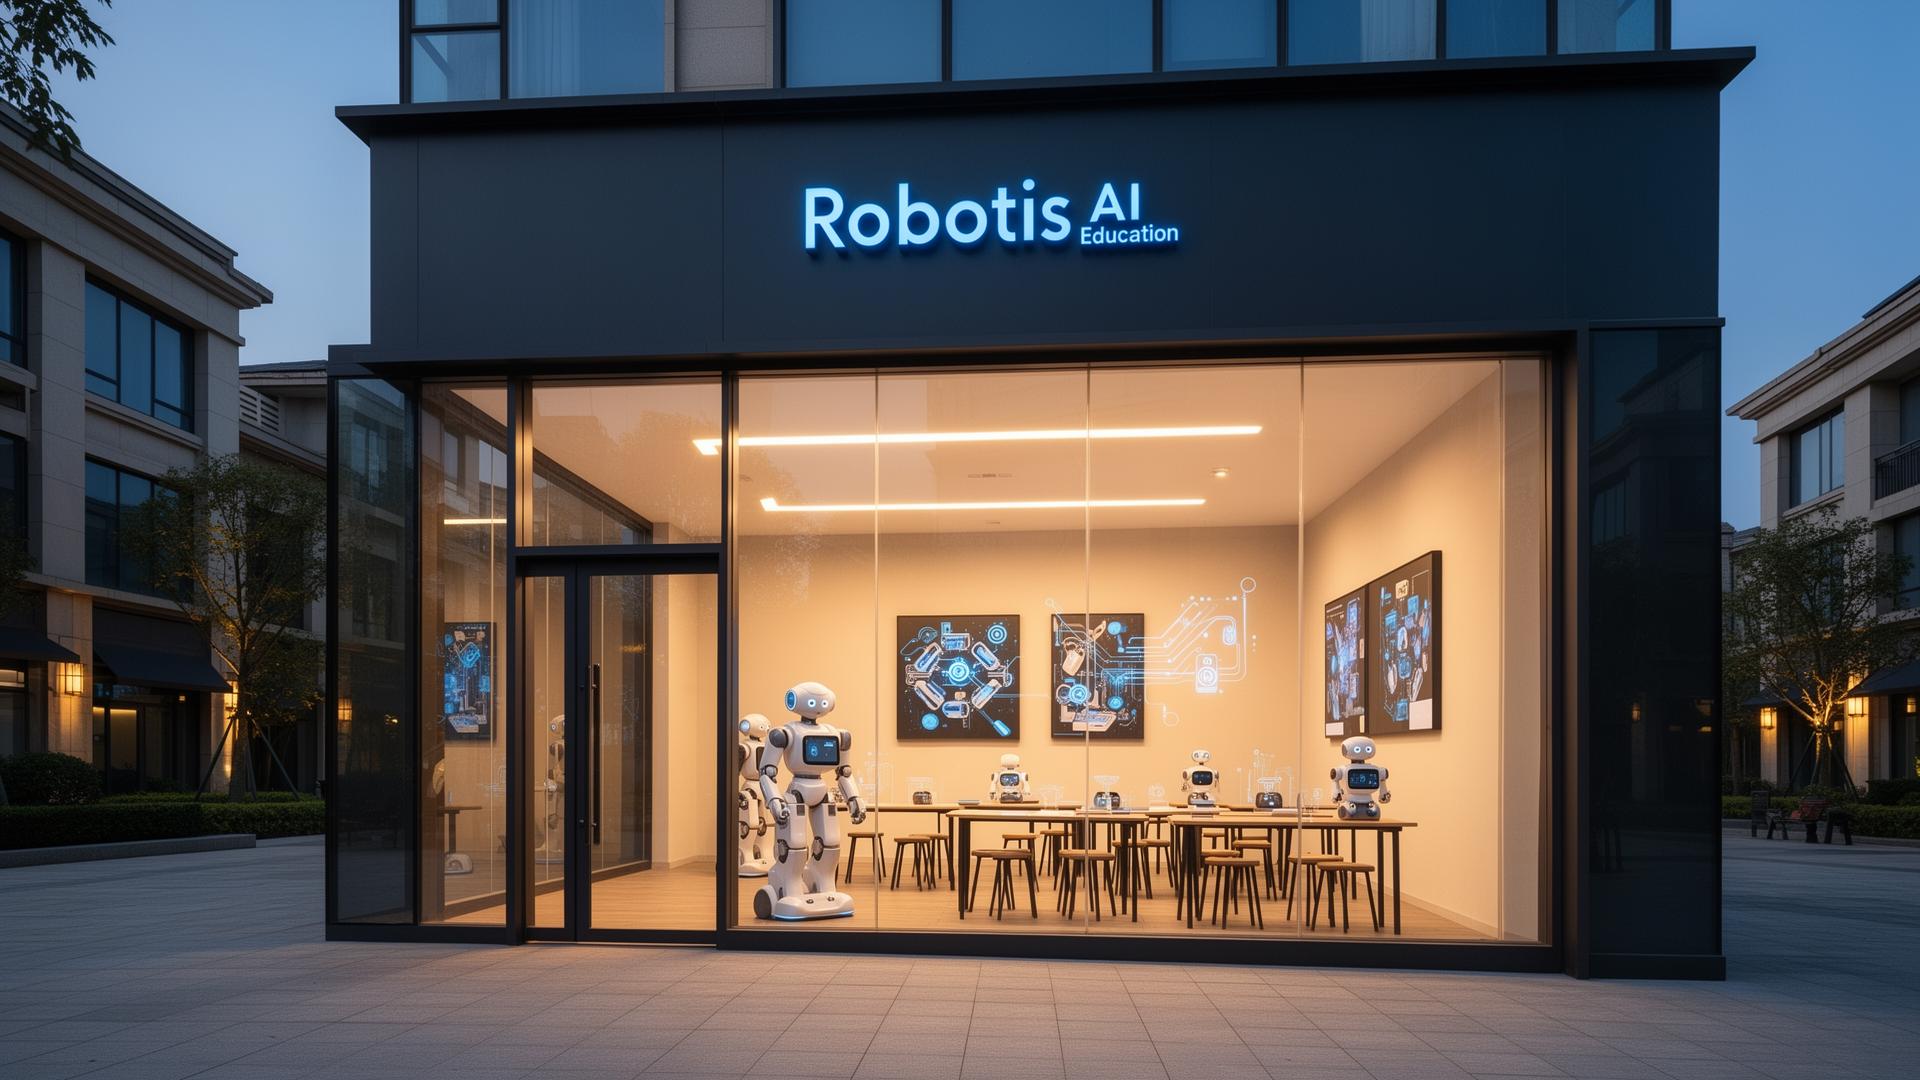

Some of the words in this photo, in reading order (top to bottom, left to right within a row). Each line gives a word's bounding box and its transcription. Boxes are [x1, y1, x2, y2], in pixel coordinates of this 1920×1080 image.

[805, 178, 1072, 249] Robotis
[1089, 182, 1140, 222] AI
[1080, 224, 1179, 245] Education
